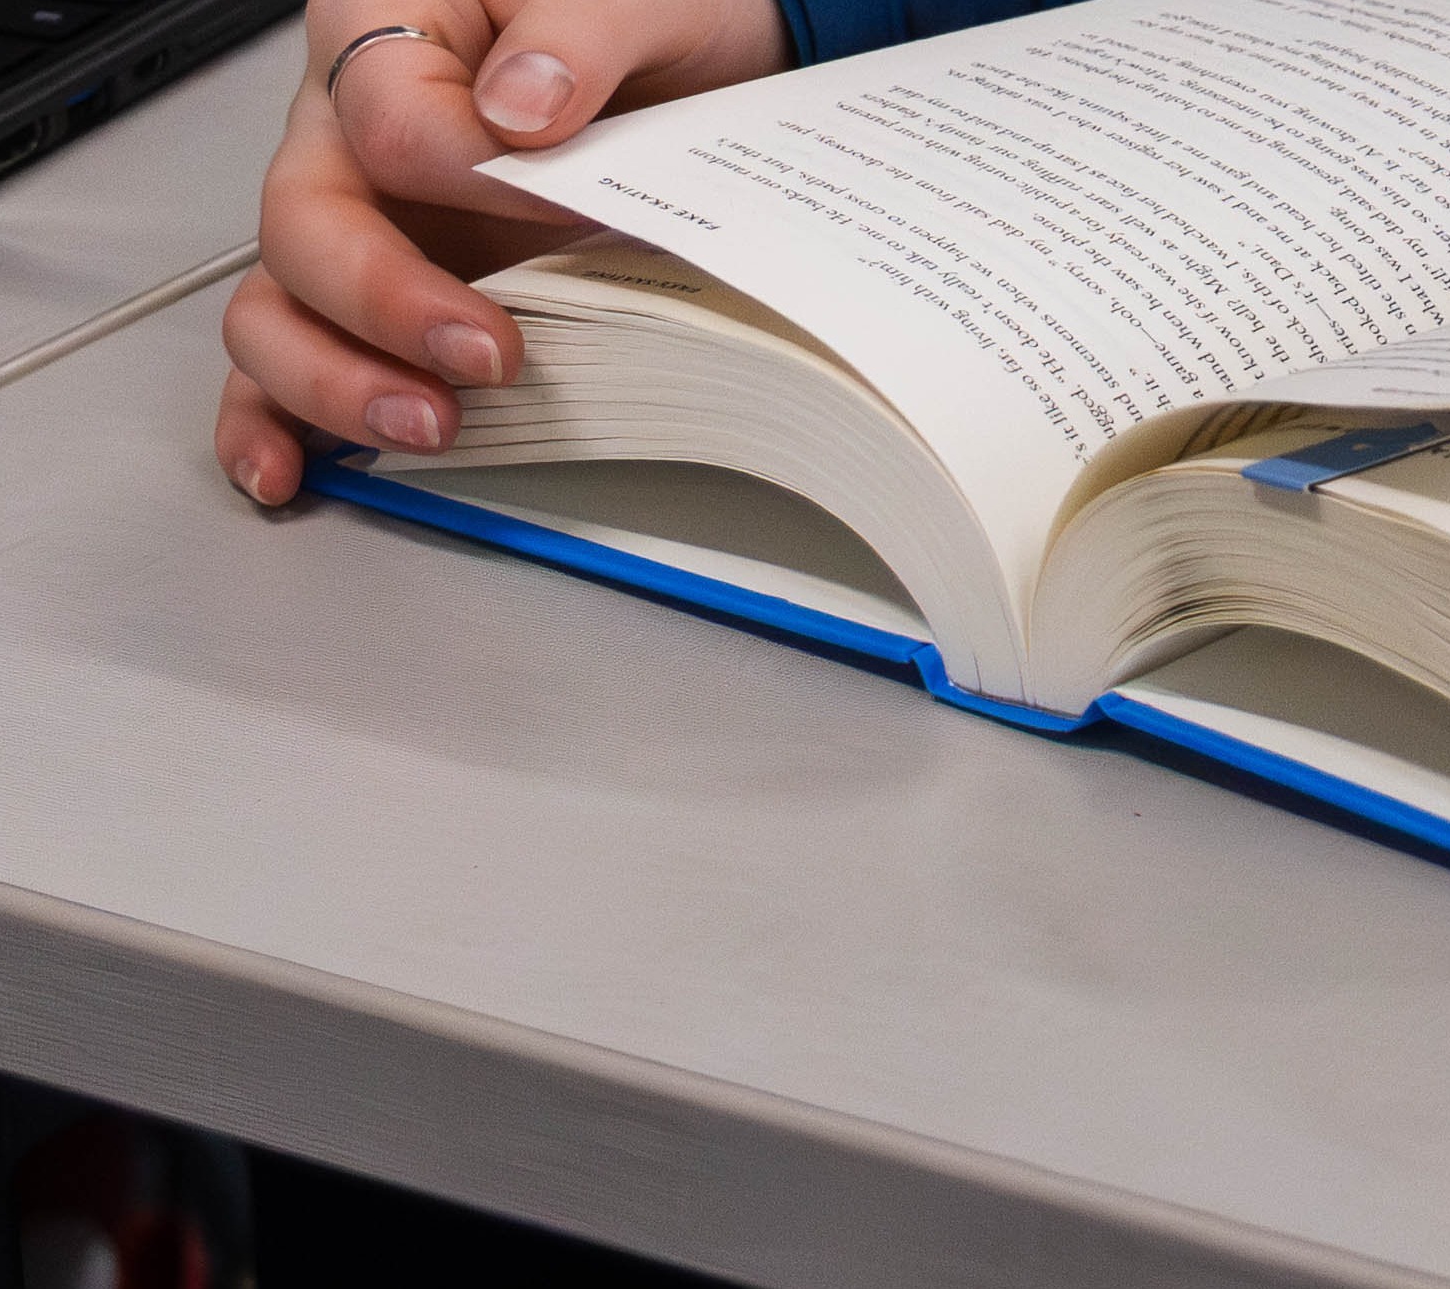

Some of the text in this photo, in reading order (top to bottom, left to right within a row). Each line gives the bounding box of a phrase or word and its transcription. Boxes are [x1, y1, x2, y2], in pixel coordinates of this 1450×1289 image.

[1307, 138, 1355, 164] going
[1162, 161, 1193, 177] her
[1192, 176, 1224, 194] saw
[1350, 165, 1379, 185] was
[597, 177, 721, 231] FAKE SKATING
[1231, 201, 1268, 222] and
[1380, 186, 1411, 208] this
[885, 166, 1106, 295] sorry," my dad said from the
[1119, 215, 1155, 236] well
[1411, 209, 1431, 223] so
[909, 226, 969, 262] happen
[1182, 145, 1406, 320] she tilted her head and me
[1266, 225, 1294, 244] me
[1369, 212, 1428, 258] my dad
[969, 261, 993, 277] we
[1179, 255, 1228, 294] Might
[1238, 241, 1294, 281] Dani."
[1375, 246, 1401, 272] was
[937, 271, 982, 300] really
[1016, 181, 1257, 371] know if she was ready for public
[1033, 213, 1202, 349] when he saw the phone.
[1136, 197, 1327, 363] shock of watched her
[1310, 261, 1347, 295] back
[913, 284, 949, 310] with
[996, 278, 1038, 312] when
[1410, 285, 1444, 325] what
[951, 309, 996, 349] living
[982, 302, 1039, 348] doesn't
[1227, 299, 1265, 333] hell?
[1040, 314, 1119, 388] statements
[1265, 336, 1290, 363] the
[1021, 374, 1042, 392] so
[1038, 351, 1065, 383] "He
[1038, 393, 1067, 425] like
[1063, 425, 1079, 441] it
